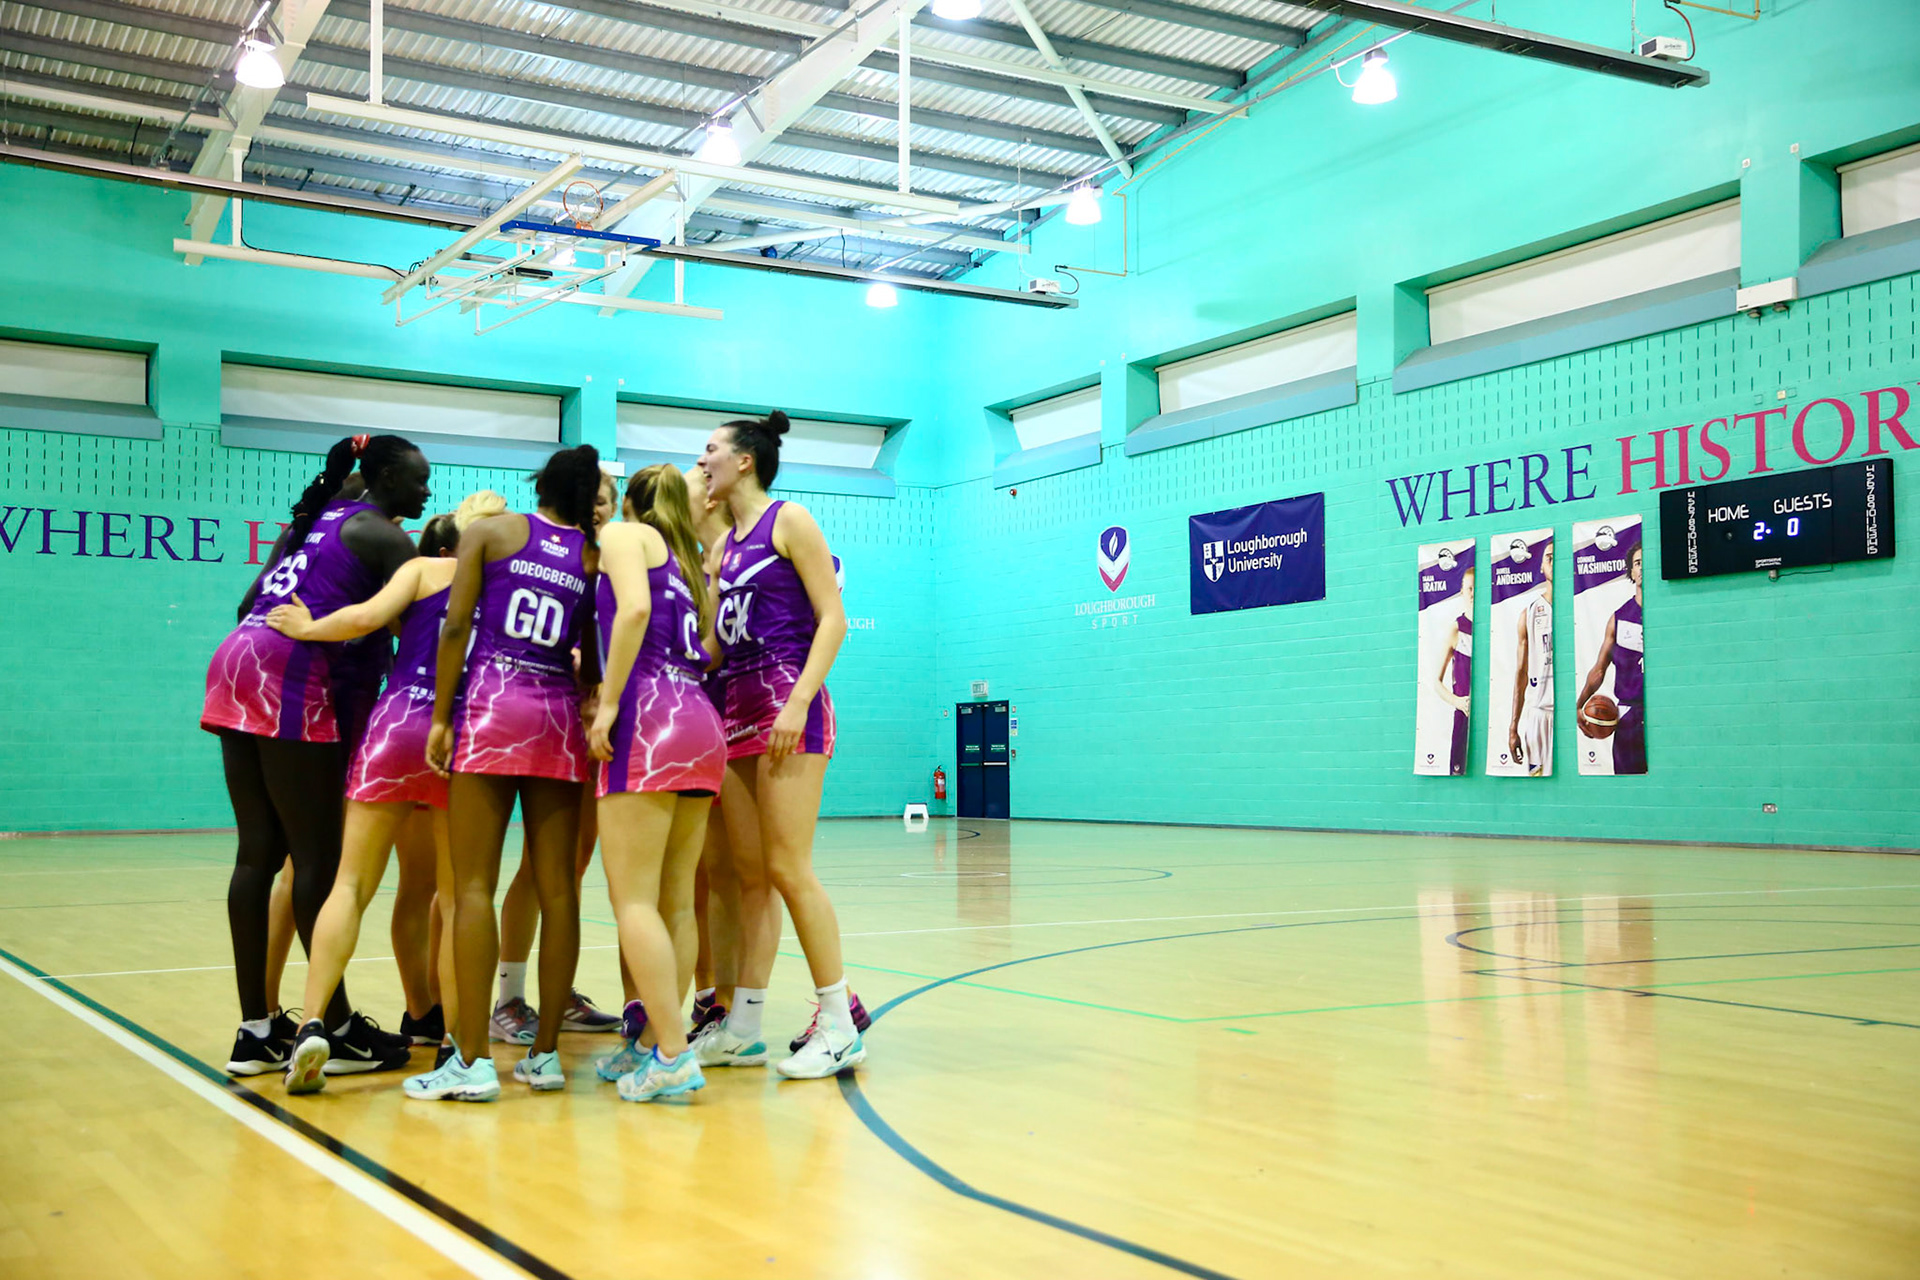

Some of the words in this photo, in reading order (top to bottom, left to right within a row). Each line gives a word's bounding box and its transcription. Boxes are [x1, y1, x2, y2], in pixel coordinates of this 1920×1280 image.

[1385, 444, 1597, 527] WHERE
[1615, 381, 1920, 495] HISTOR
[1708, 504, 1750, 523] HOME
[1774, 493, 1832, 514] GUESTS
[1787, 517, 1799, 537] 0
[1227, 528, 1307, 555] Loughborough
[1228, 552, 1282, 573] University
[510, 559, 586, 595] ODEOGBERIN
[1496, 571, 1533, 586] ANDERSON
[504, 587, 564, 648] GD
[717, 591, 753, 646] GK
[1074, 594, 1156, 616] LOUGHBOROUGH
[1091, 614, 1138, 631] SPORT
